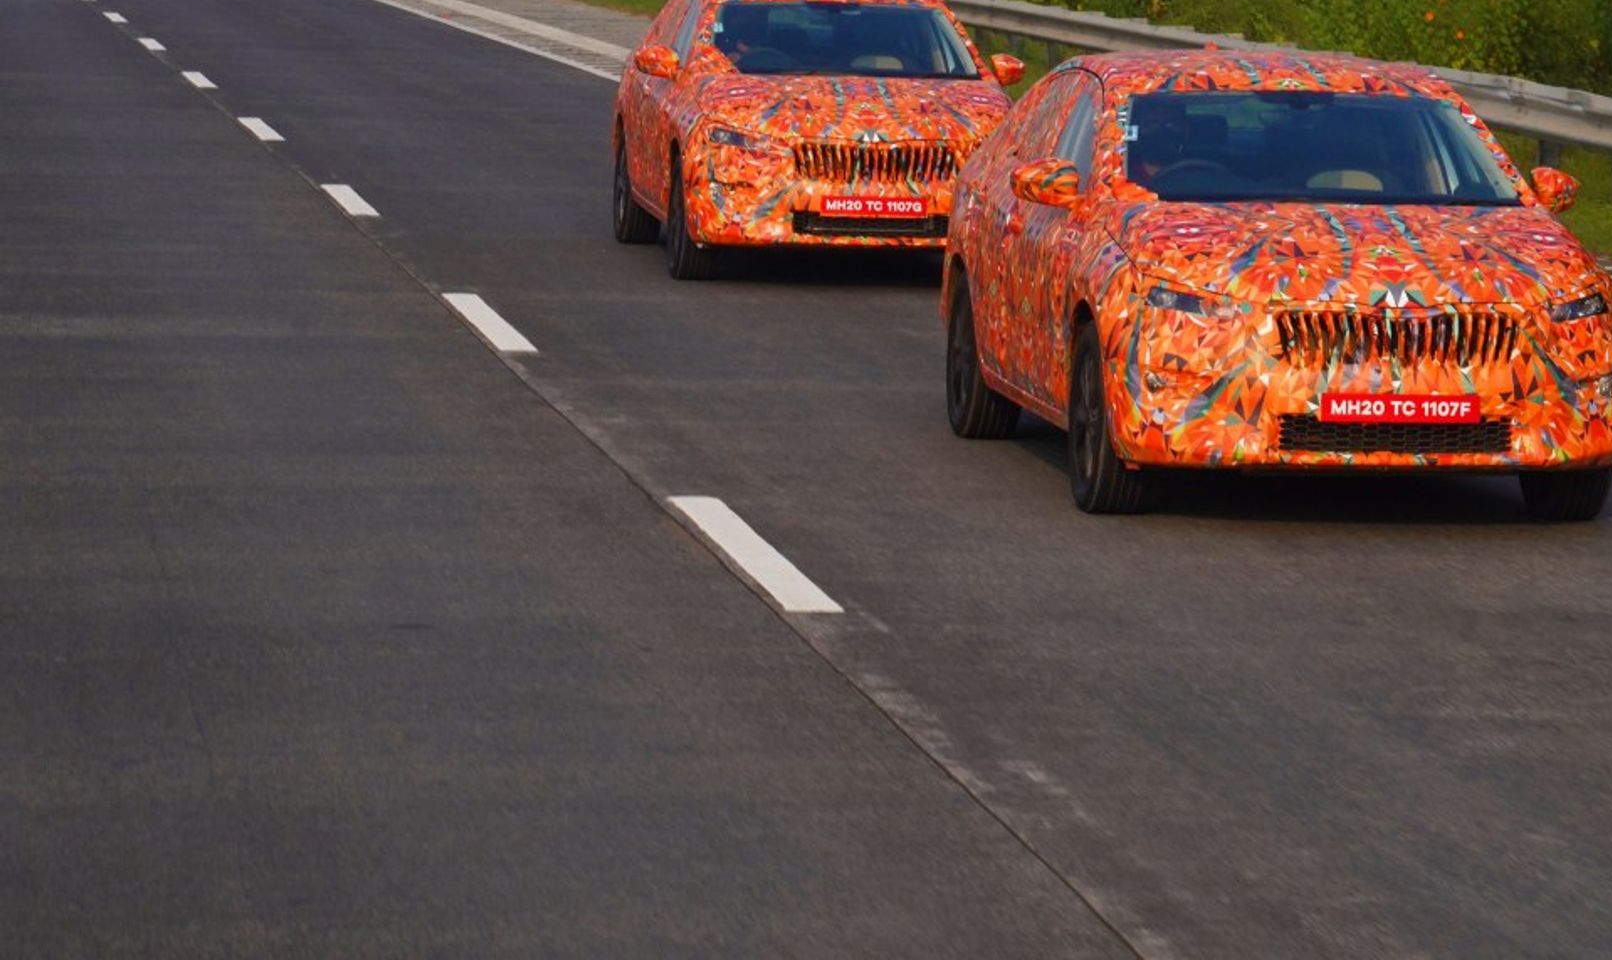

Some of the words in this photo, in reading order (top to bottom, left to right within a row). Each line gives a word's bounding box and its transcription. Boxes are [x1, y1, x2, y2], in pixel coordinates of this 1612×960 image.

[826, 199, 863, 211] MH20
[866, 200, 883, 211] TC
[887, 200, 922, 213] 1107G
[1330, 400, 1386, 416] MH20
[1391, 400, 1416, 416] TC
[1421, 401, 1471, 417] 1107F
